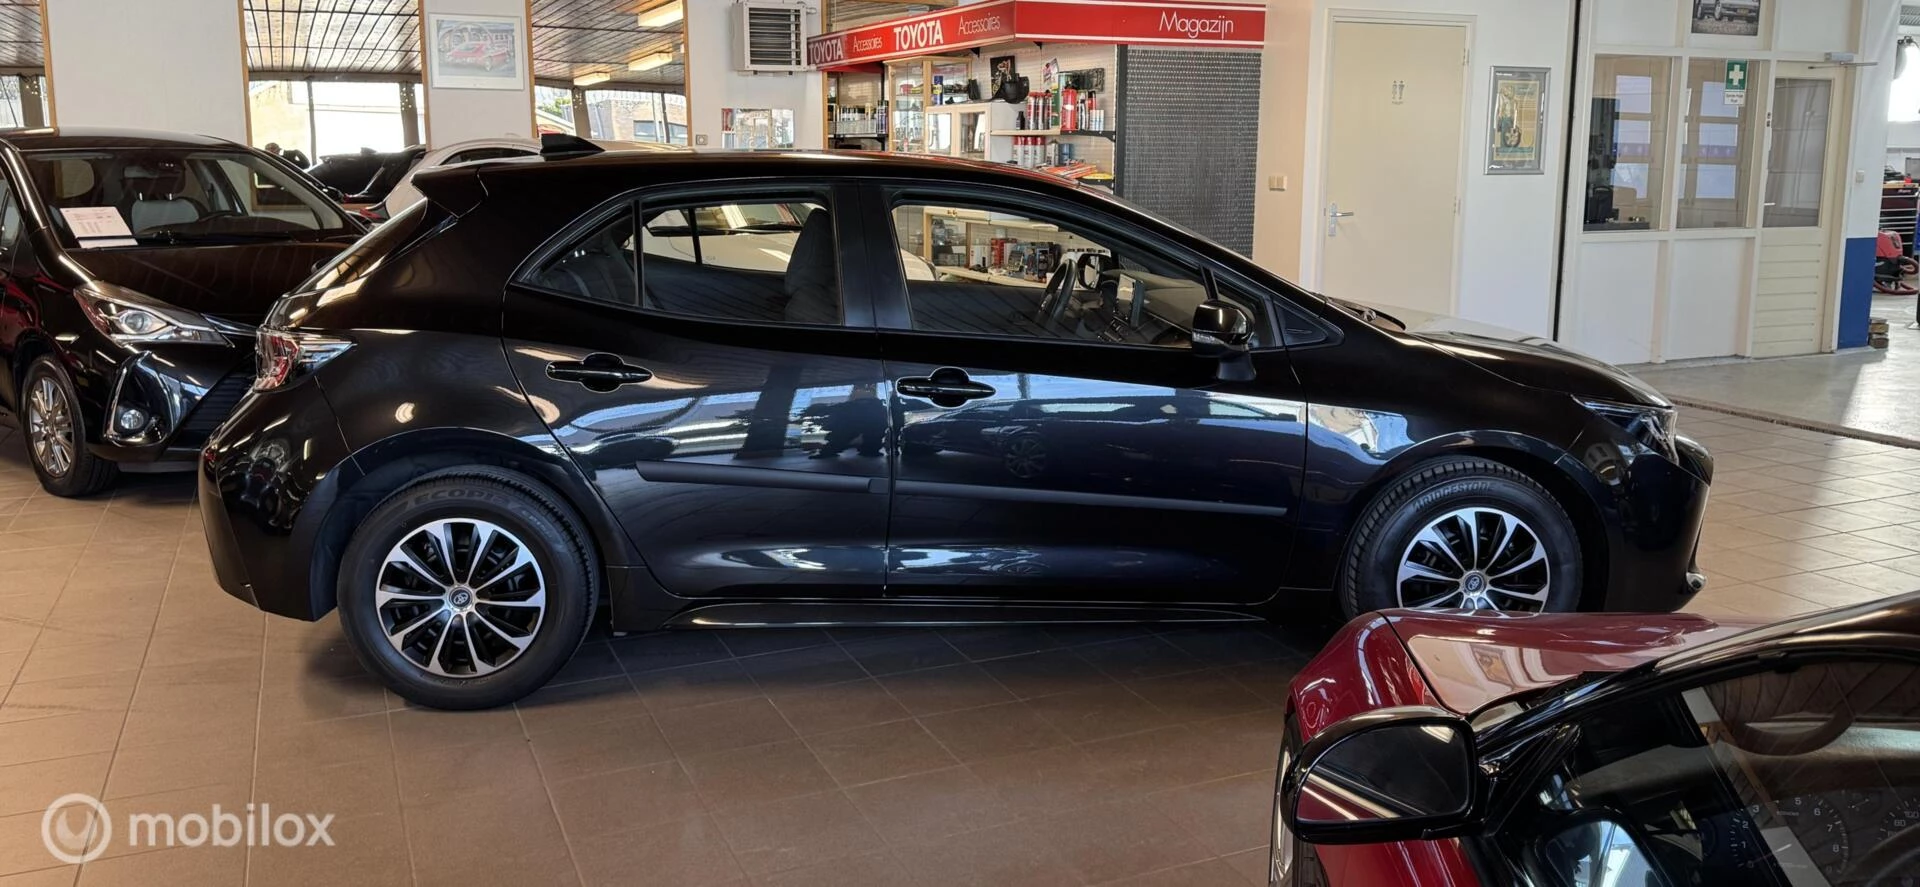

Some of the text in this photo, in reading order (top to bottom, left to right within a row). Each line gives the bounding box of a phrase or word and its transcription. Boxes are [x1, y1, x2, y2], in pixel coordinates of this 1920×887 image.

[1159, 11, 1234, 40] Magazijn
[808, 13, 1001, 64] TOYOTA Accessoires TOYOTA Accessoires
[1794, 797, 1802, 805] 5
[1753, 805, 1760, 813] 3
[1814, 807, 1821, 816] 6
[1742, 821, 1749, 829] 2
[1826, 824, 1833, 832] 7
[1741, 841, 1747, 849] 1
